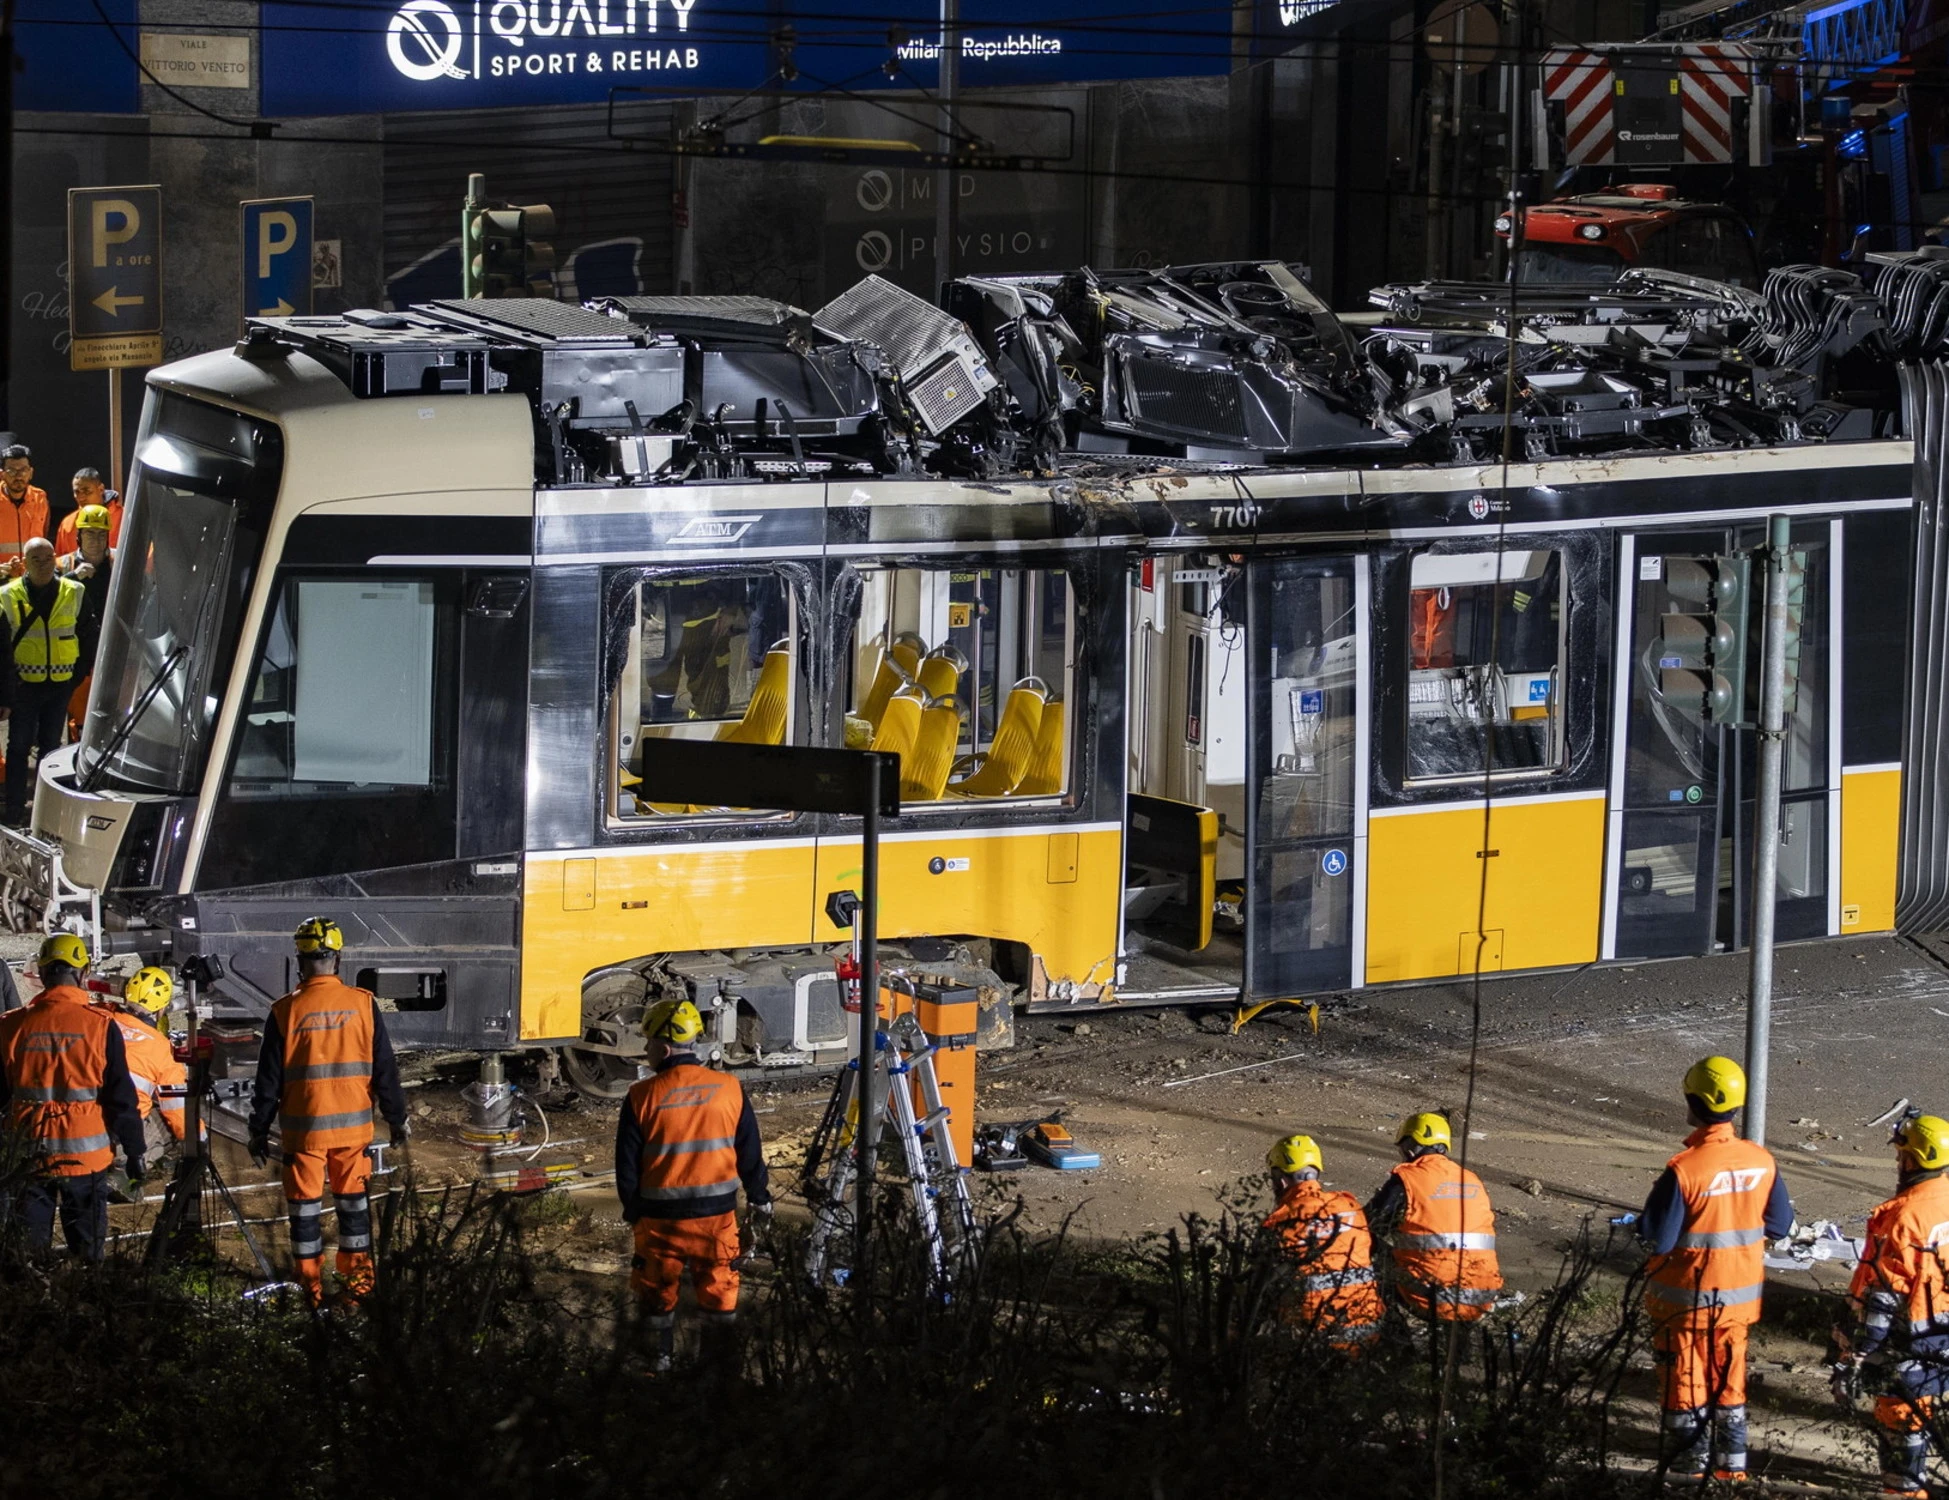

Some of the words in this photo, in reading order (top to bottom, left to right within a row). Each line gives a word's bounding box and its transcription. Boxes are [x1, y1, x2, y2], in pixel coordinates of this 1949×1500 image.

[490, 0, 698, 47] QUALITY
[180, 40, 207, 49] VIALE
[962, 34, 1062, 61] Repubblica
[144, 60, 196, 72] VITTORIO
[201, 62, 246, 73] VENETO
[490, 53, 577, 77] SPORT
[586, 52, 603, 73] &
[612, 48, 699, 71] REHAB
[912, 175, 975, 199] MD
[92, 199, 140, 268] P
[259, 210, 297, 279] P
[911, 231, 1032, 260] PYSIO
[129, 255, 152, 266] ore
[1210, 506, 1262, 528] 7707
